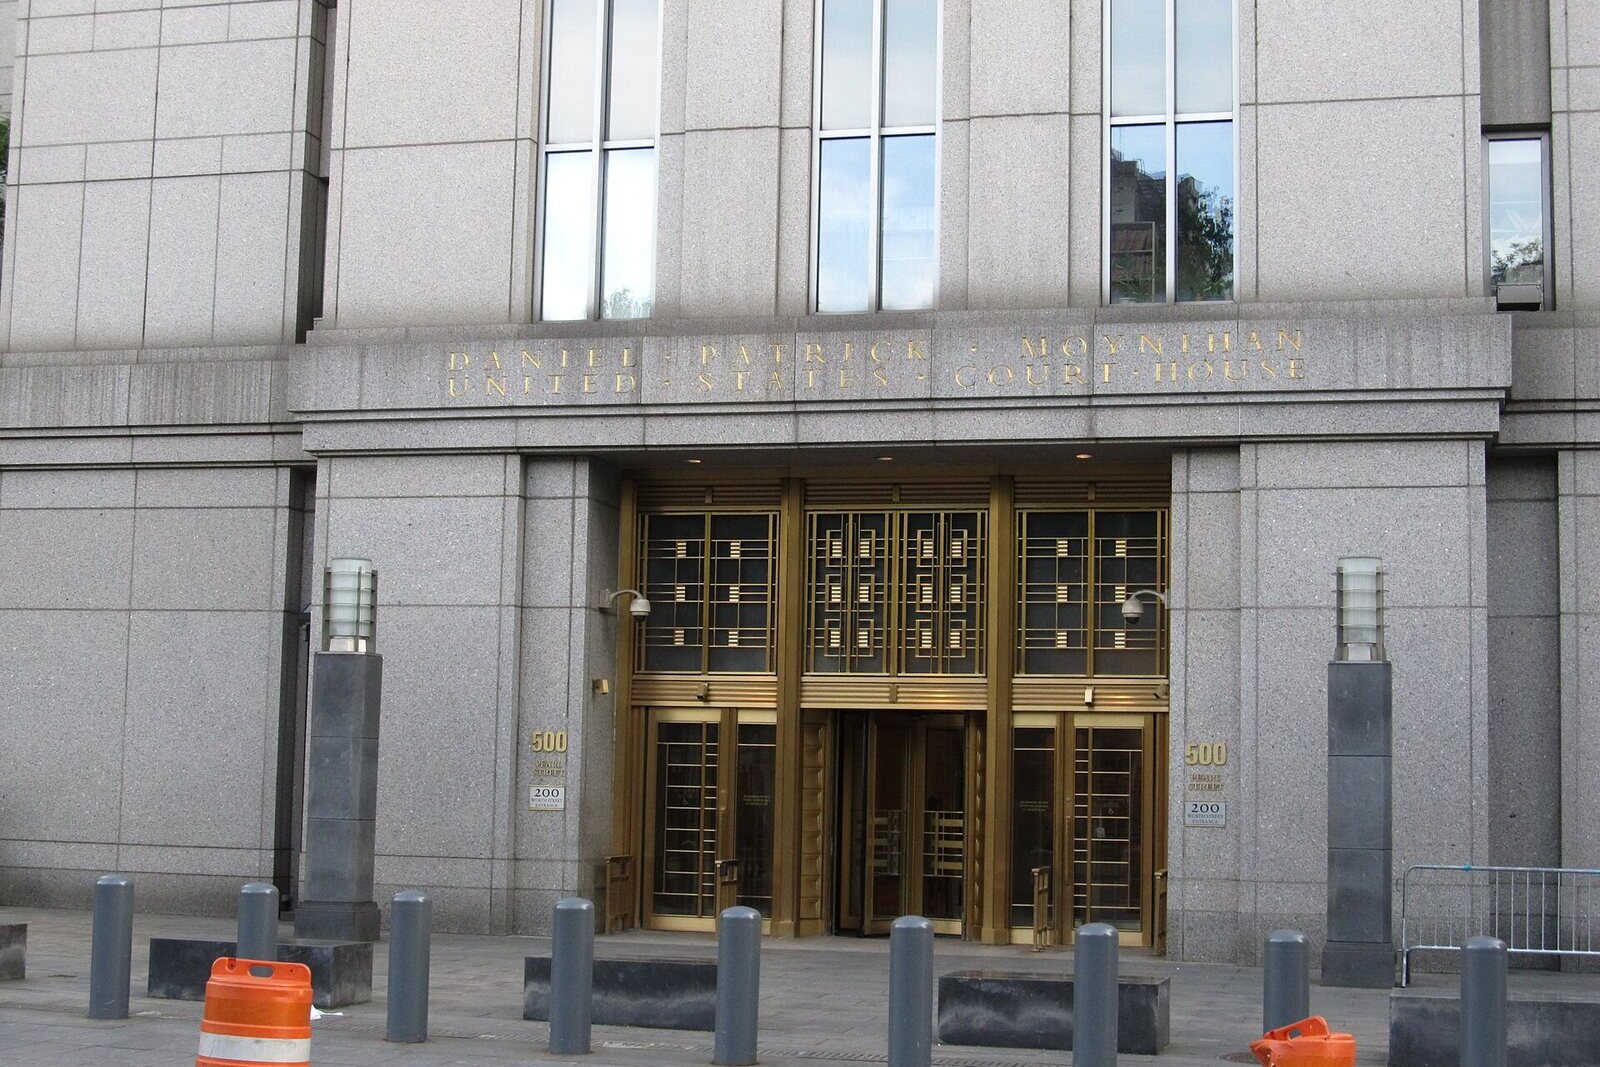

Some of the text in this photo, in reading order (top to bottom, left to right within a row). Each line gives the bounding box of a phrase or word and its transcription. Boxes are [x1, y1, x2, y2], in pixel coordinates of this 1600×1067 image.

[448, 329, 1305, 372] DANIEL PATRICK MOYNIHAN
[448, 372, 637, 398] UNITED
[699, 365, 889, 393] STATES
[531, 731, 568, 752] 500
[1185, 742, 1227, 766] 500
[534, 788, 560, 797] 200
[1191, 803, 1220, 813] 200
